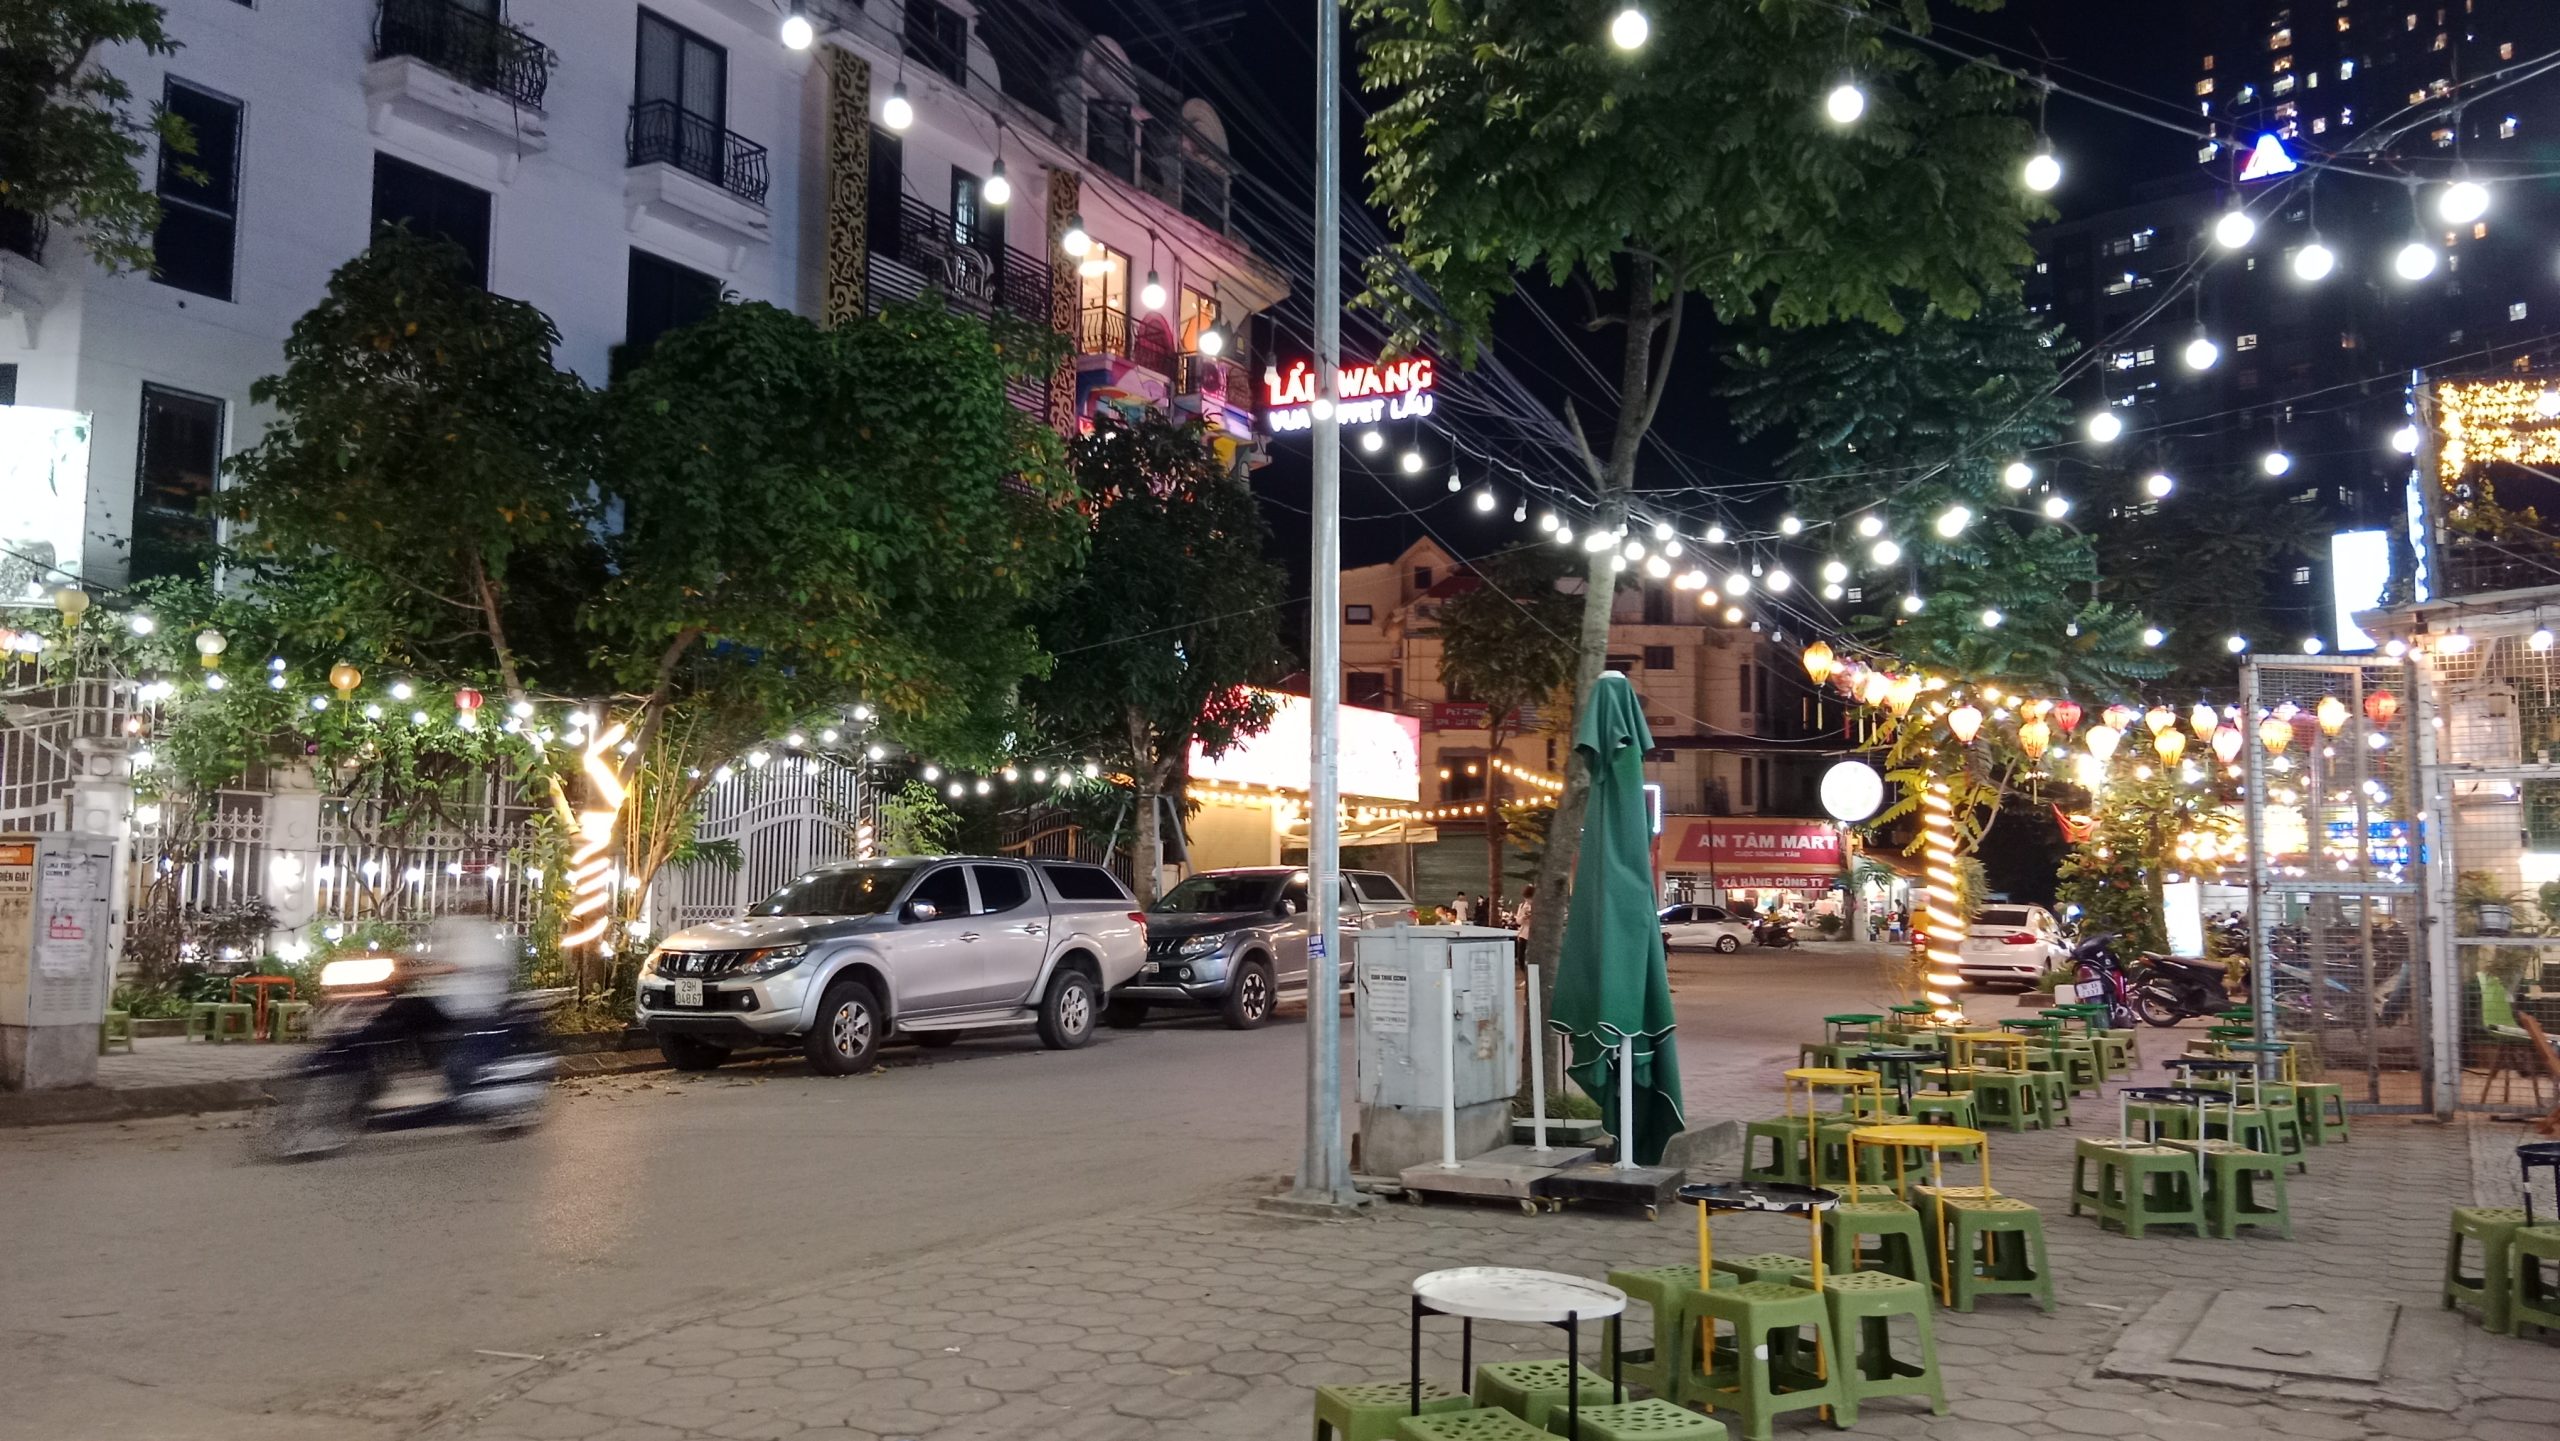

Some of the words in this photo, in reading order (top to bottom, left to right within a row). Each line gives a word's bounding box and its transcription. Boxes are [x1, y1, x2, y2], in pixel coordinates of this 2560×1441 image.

[1338, 360, 1433, 398] WANG
[1697, 835, 1726, 848] AN
[1732, 832, 1775, 848] TÂM
[1781, 835, 1838, 849] MART
[1740, 875, 1772, 887] HÀNG
[1775, 876, 1808, 887] CÔNG
[1810, 878, 1825, 887] TY
[681, 981, 697, 992] 29H
